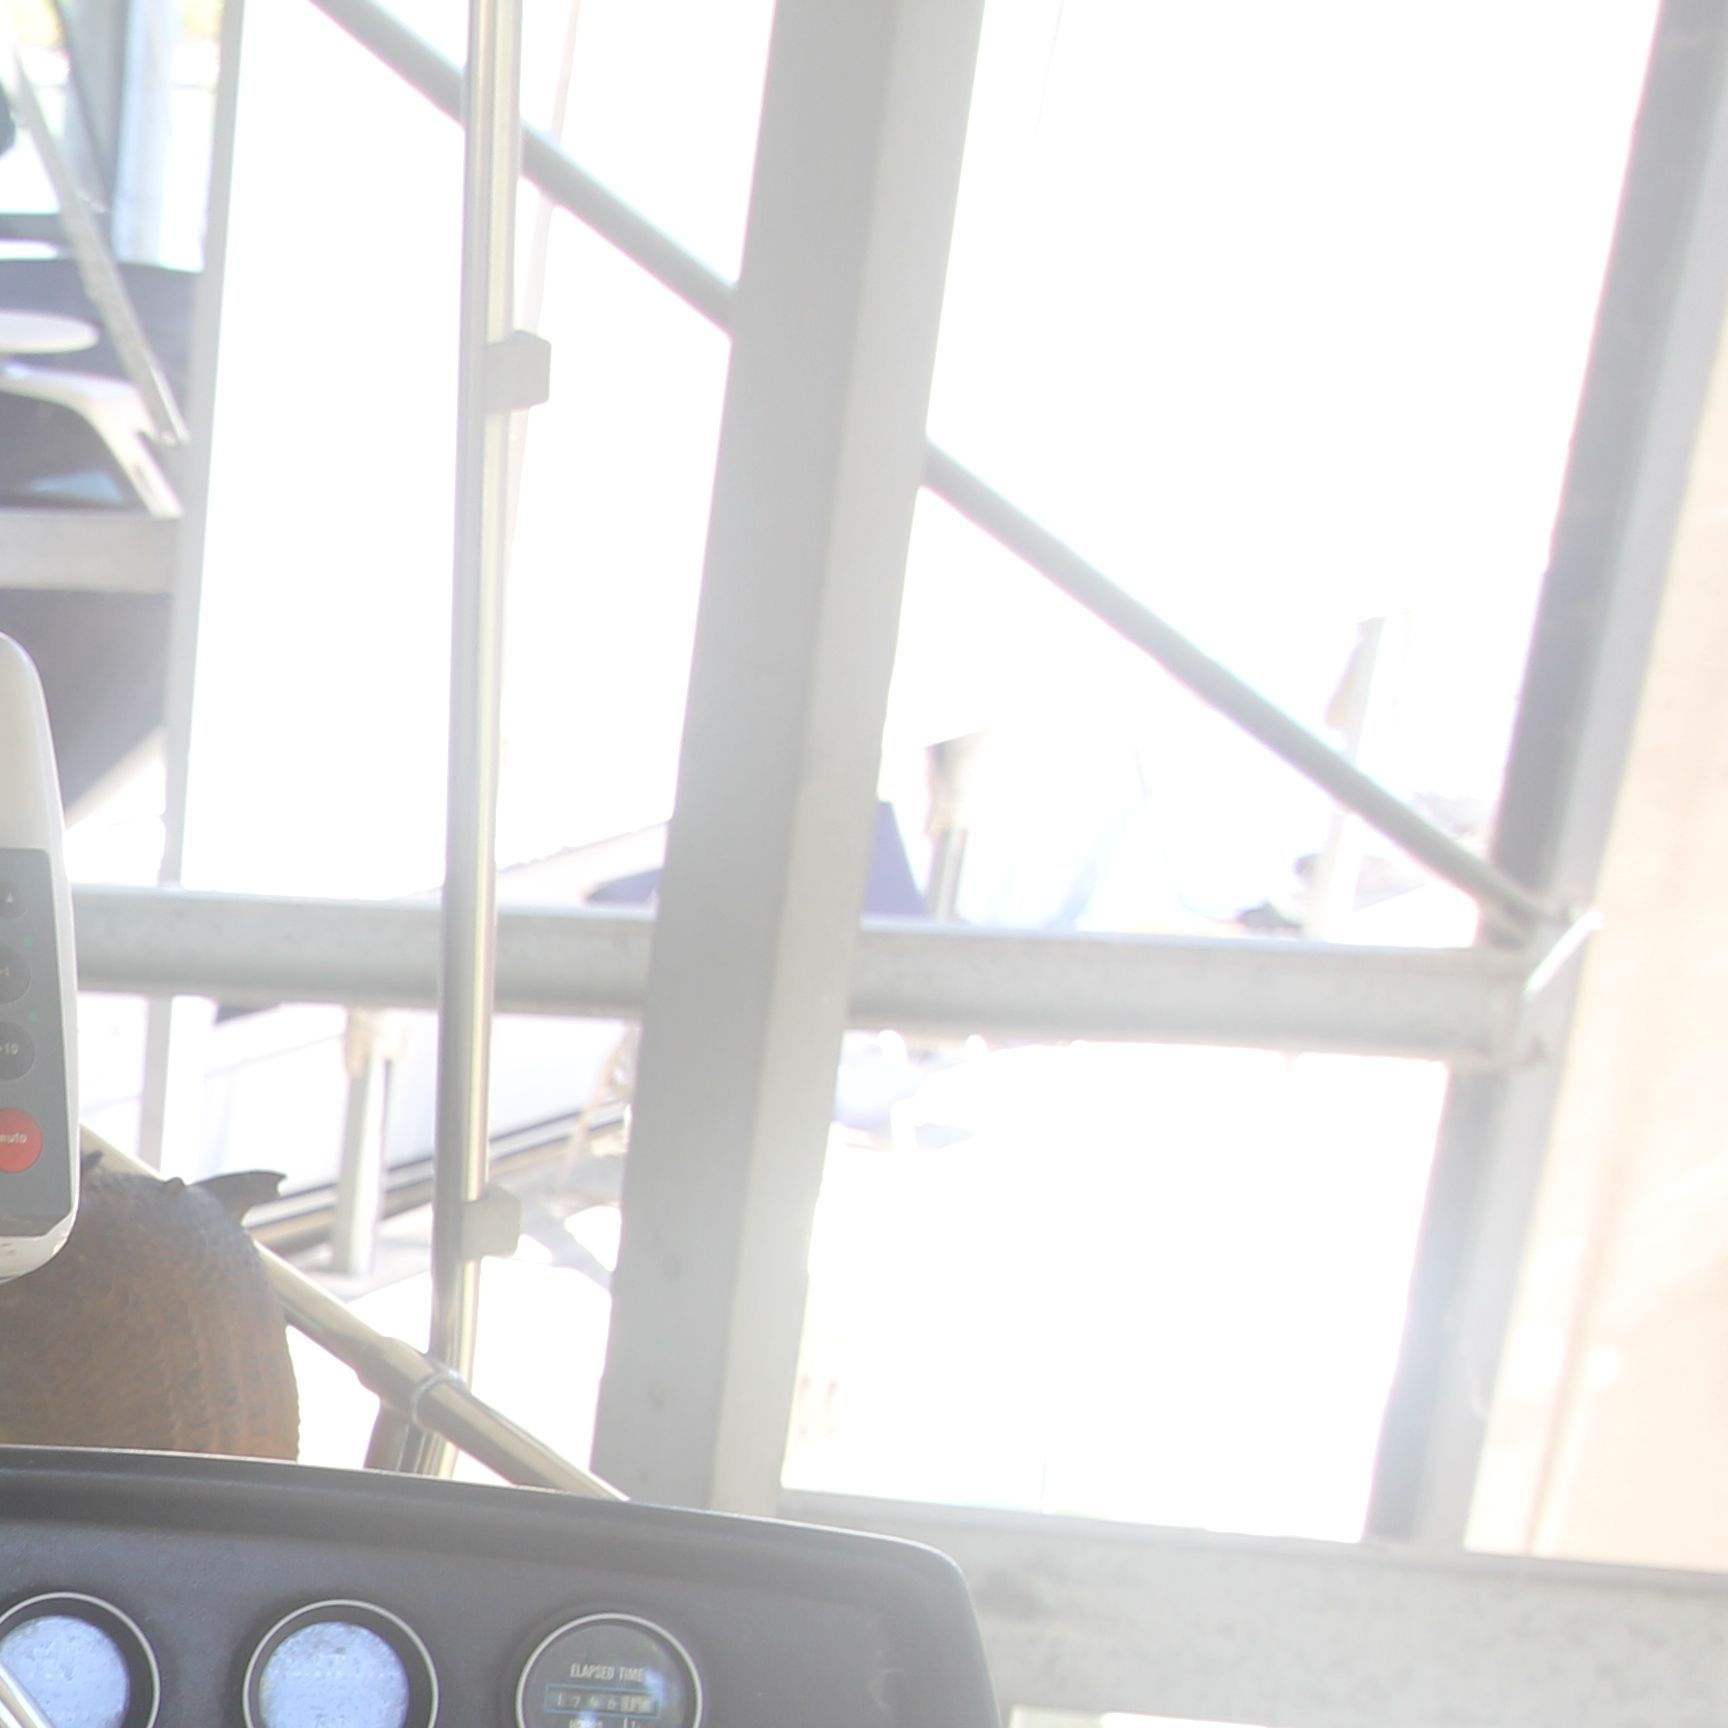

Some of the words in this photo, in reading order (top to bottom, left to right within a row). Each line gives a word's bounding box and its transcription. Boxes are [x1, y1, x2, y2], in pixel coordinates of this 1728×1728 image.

[0, 1133, 27, 1143] auto
[569, 1663, 615, 1681] ELAPSED
[619, 1666, 644, 1681] TIME
